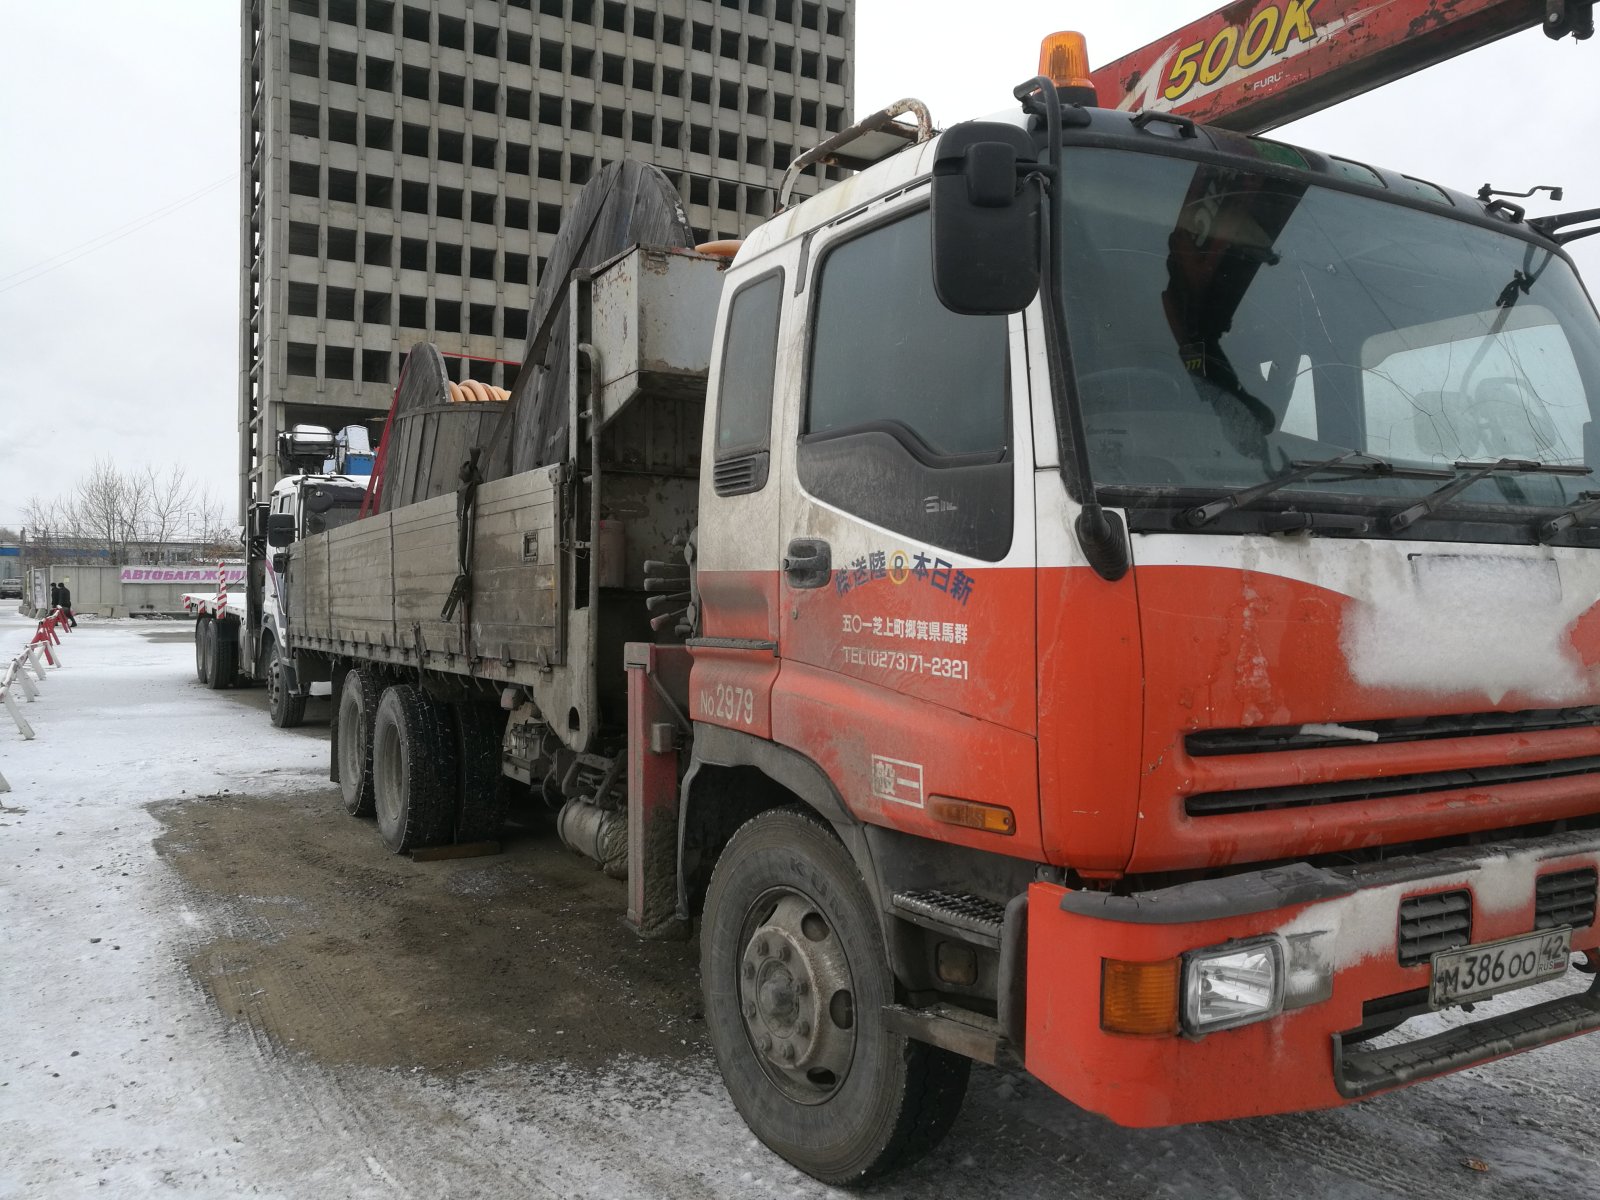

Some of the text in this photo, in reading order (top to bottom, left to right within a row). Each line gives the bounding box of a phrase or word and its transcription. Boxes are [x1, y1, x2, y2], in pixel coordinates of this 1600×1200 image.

[1164, 0, 1317, 100] 500K
[121, 569, 247, 581] АВТОБАГАЖИ
[1539, 961, 1554, 971] RUS
